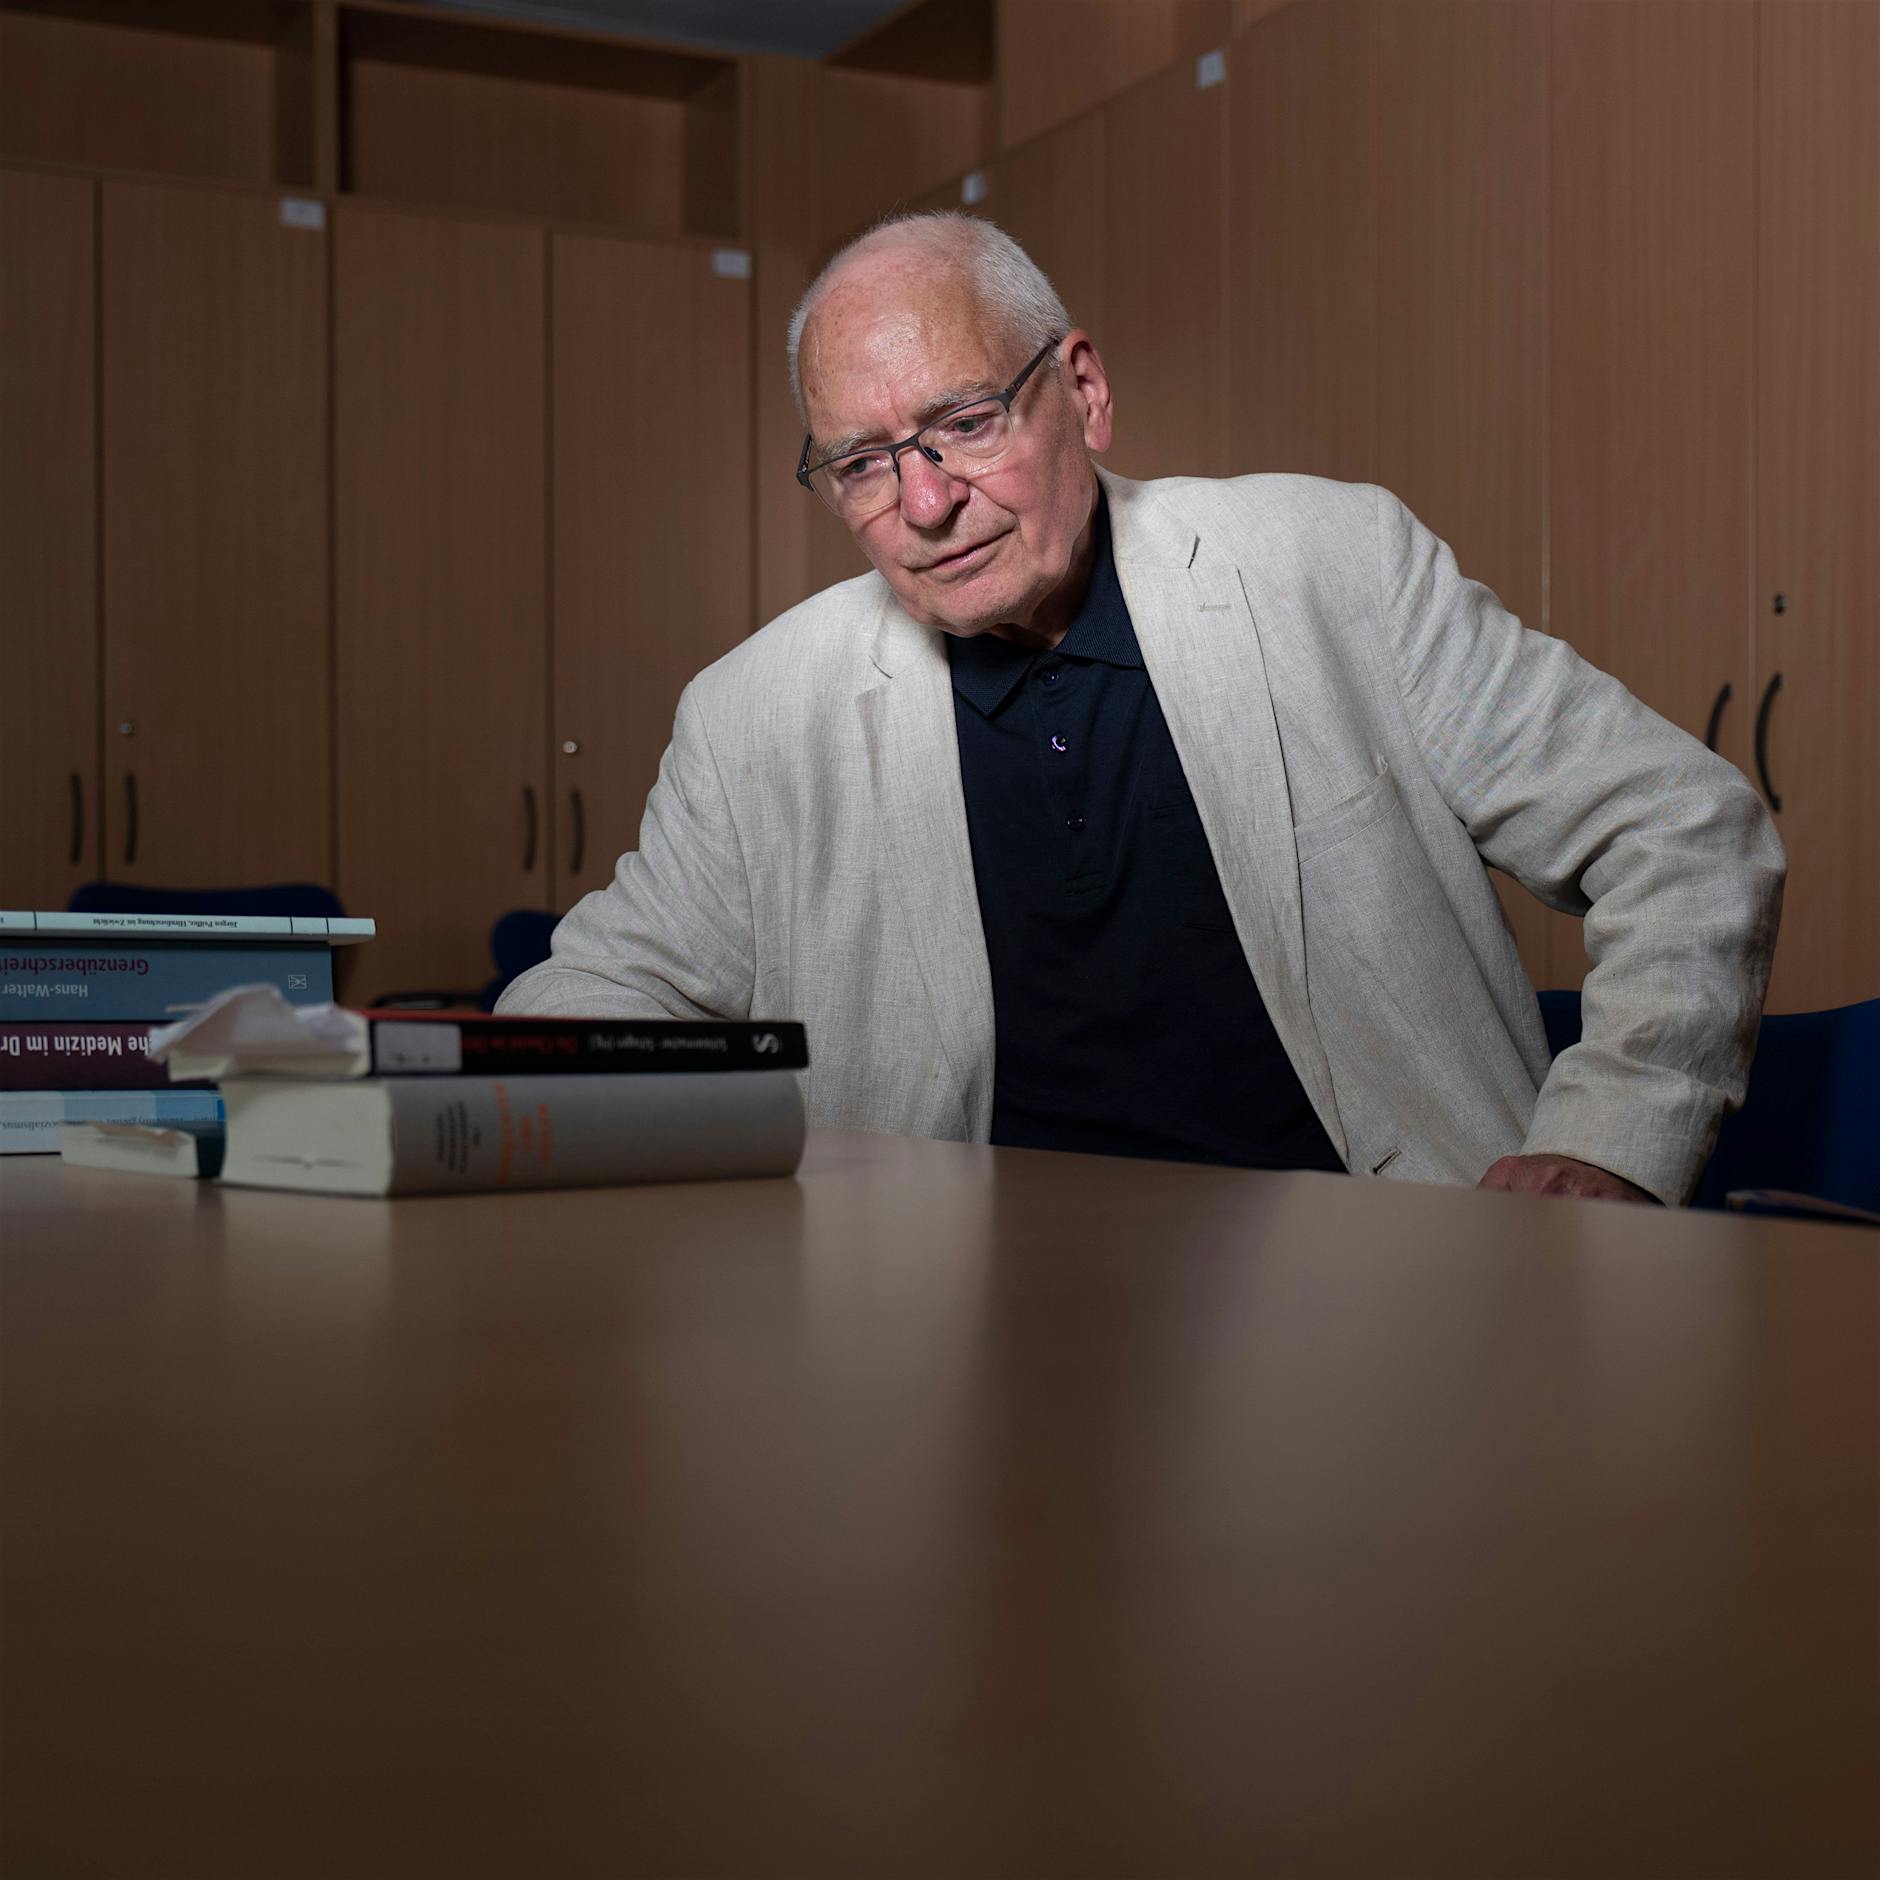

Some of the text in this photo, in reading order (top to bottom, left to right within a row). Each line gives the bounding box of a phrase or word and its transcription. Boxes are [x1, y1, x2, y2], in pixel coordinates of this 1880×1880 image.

[2, 984, 88, 997] Hans-Walter
[26, 1036, 48, 1056] im
[54, 1036, 122, 1056] Medizin
[128, 1036, 151, 1056] he
